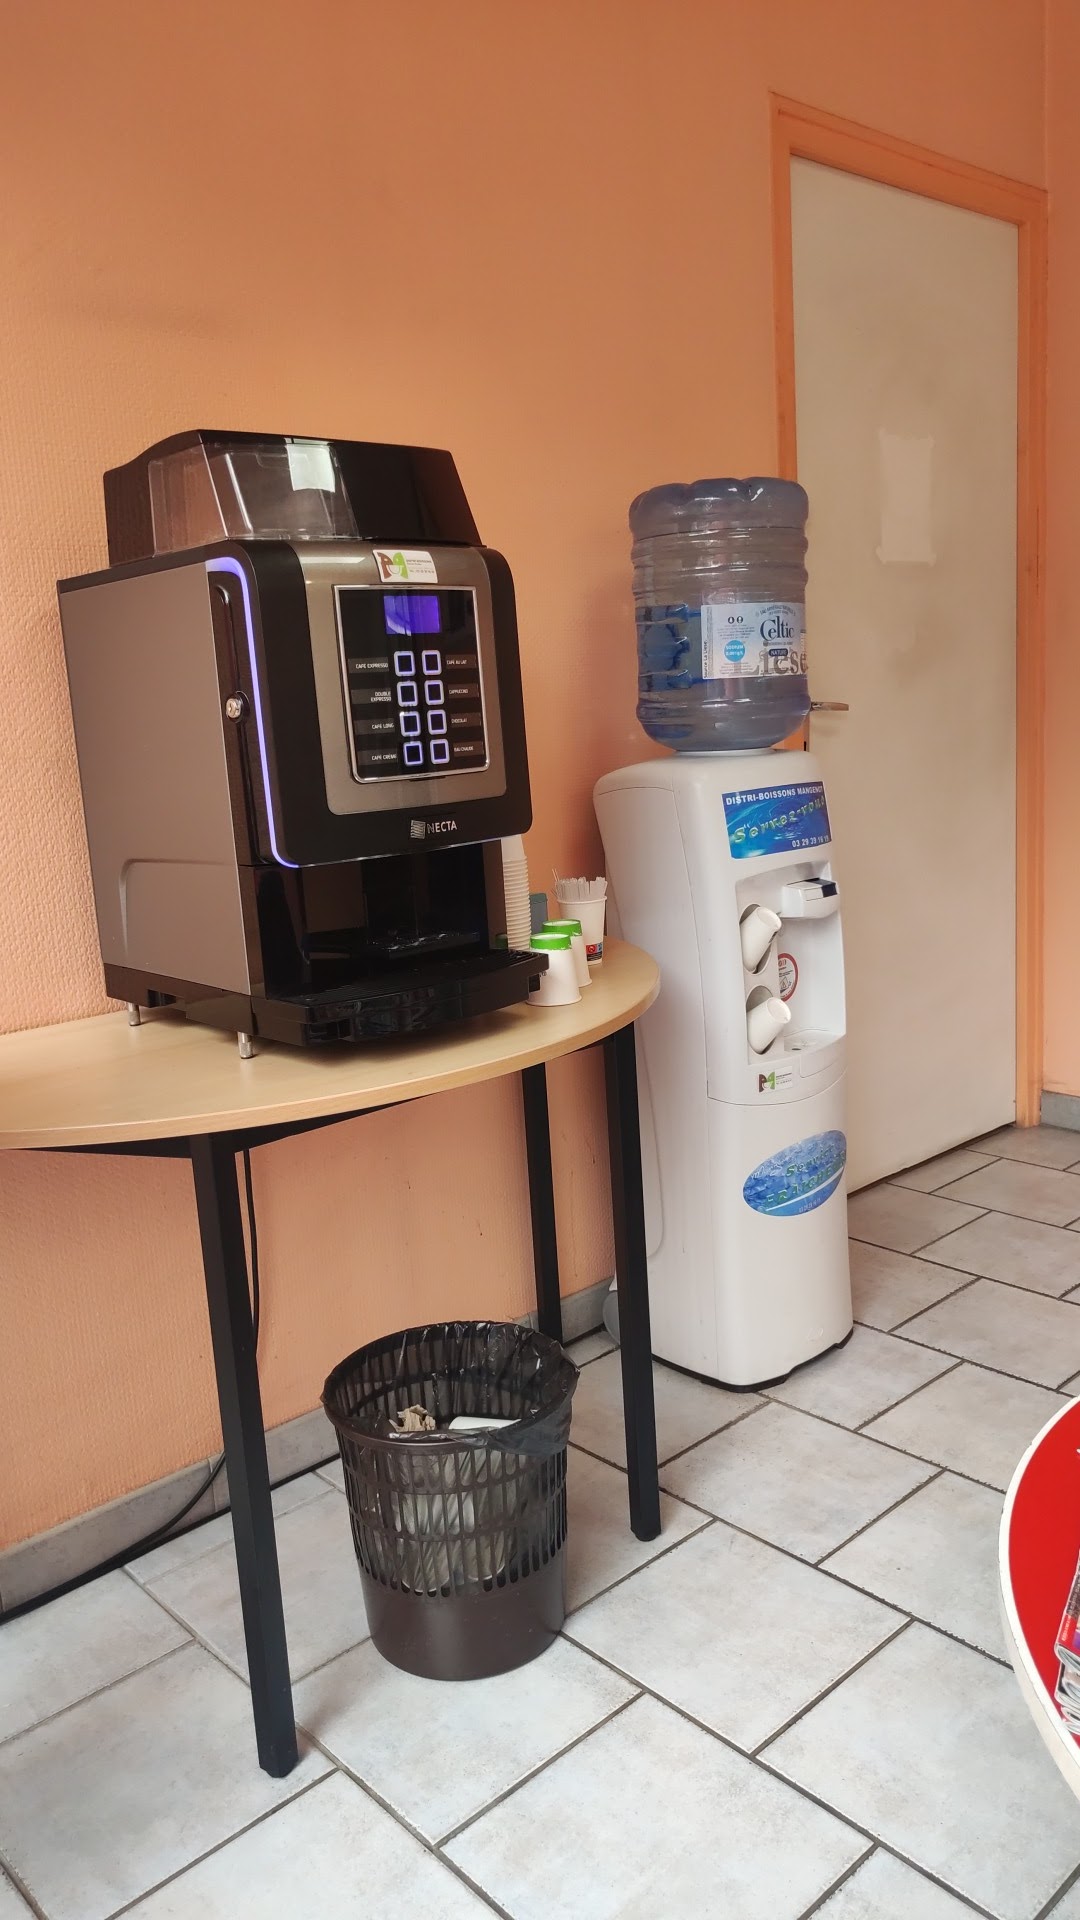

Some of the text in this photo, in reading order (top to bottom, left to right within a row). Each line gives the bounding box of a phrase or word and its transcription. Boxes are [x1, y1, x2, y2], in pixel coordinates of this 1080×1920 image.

[760, 615, 794, 641] Celtic
[725, 788, 796, 806] DISTRI-BOISSONS
[427, 820, 457, 834] NECTA
[792, 839, 801, 848] 03
